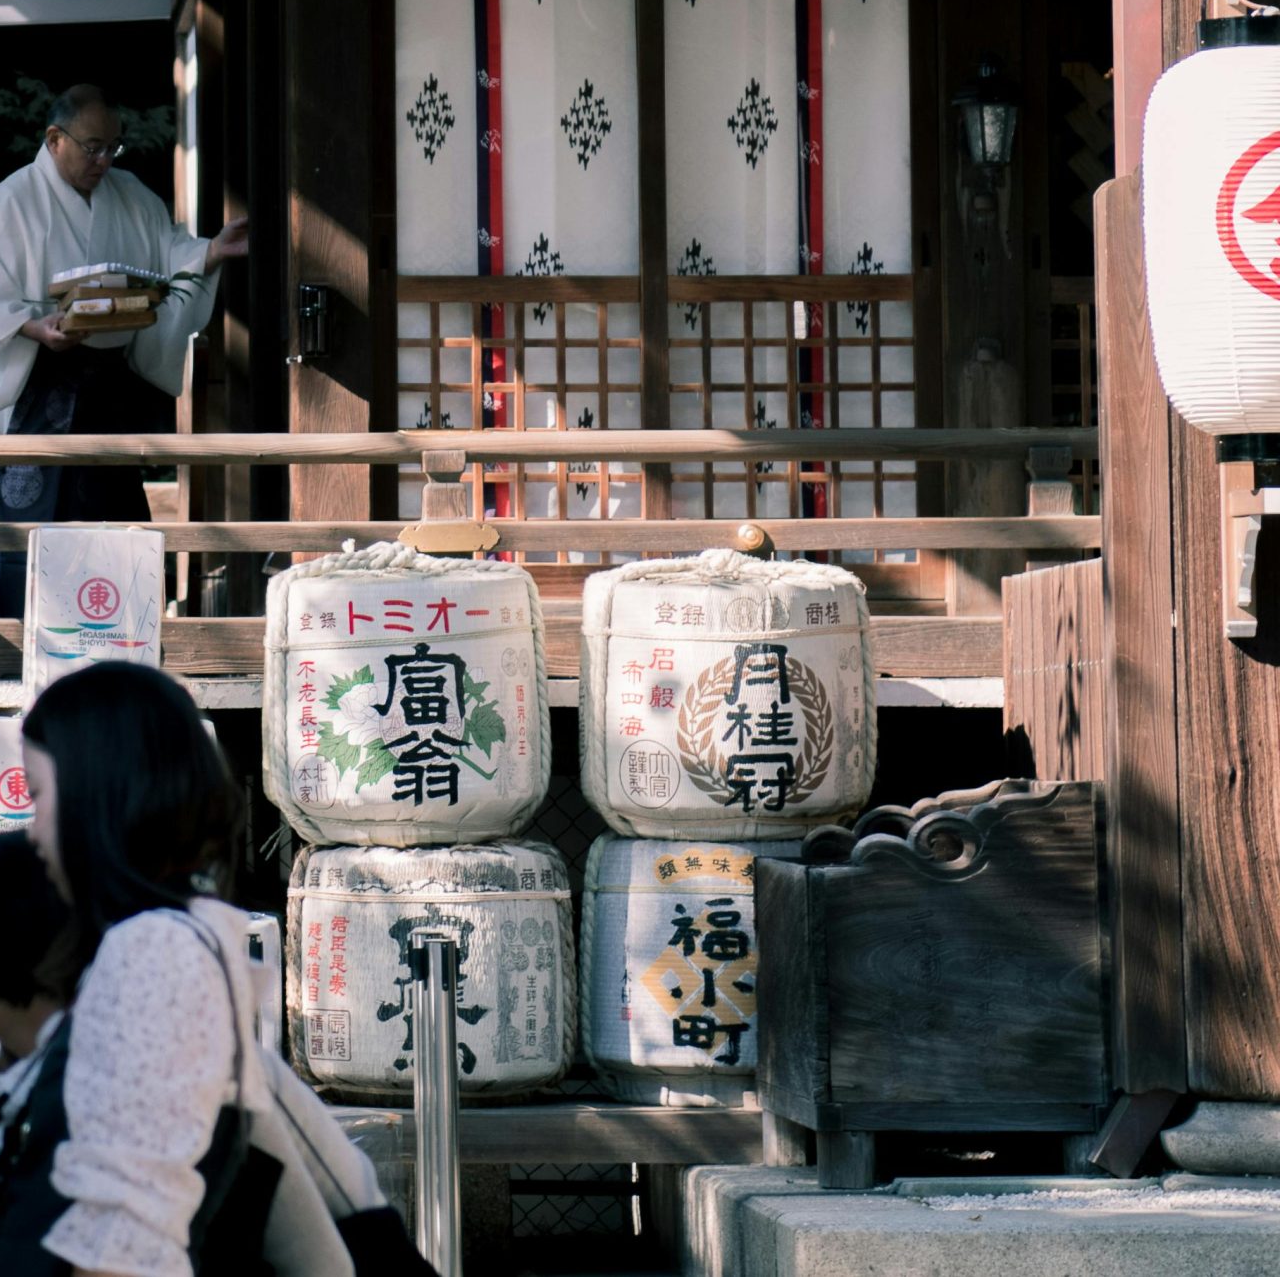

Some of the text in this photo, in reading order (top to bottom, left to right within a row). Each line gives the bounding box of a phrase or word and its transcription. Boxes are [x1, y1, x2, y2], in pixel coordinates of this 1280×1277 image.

[348, 596, 489, 635] トミオー
[654, 601, 841, 626] 登録 商標
[296, 660, 321, 750] 不老長生
[373, 642, 472, 807] 富翁
[721, 642, 798, 813] 月桂冠
[668, 897, 755, 1066] 福小町
